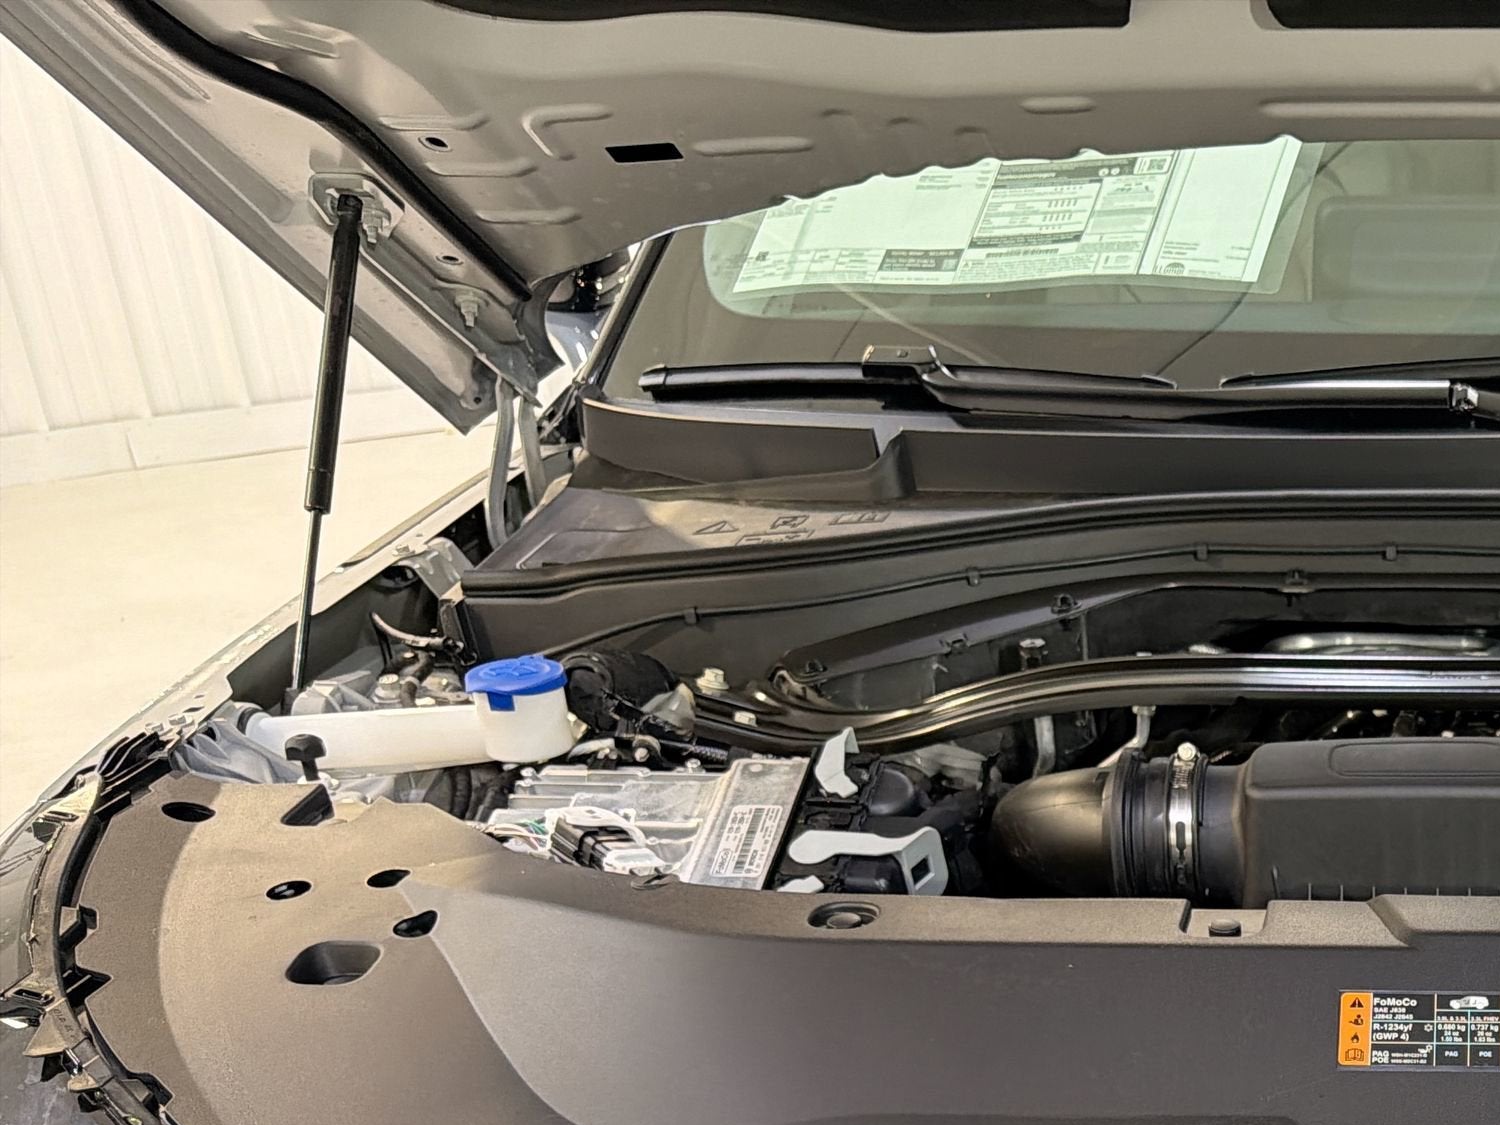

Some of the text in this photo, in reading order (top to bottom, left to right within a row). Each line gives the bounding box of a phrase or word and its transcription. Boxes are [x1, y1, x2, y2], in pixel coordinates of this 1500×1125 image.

[1374, 997, 1417, 1006] FoMoCo
[1373, 1023, 1413, 1032] R-1234yf
[1457, 1024, 1466, 1032] kg
[1490, 1024, 1499, 1032] kg
[1373, 1033, 1410, 1041] (GWP 4)
